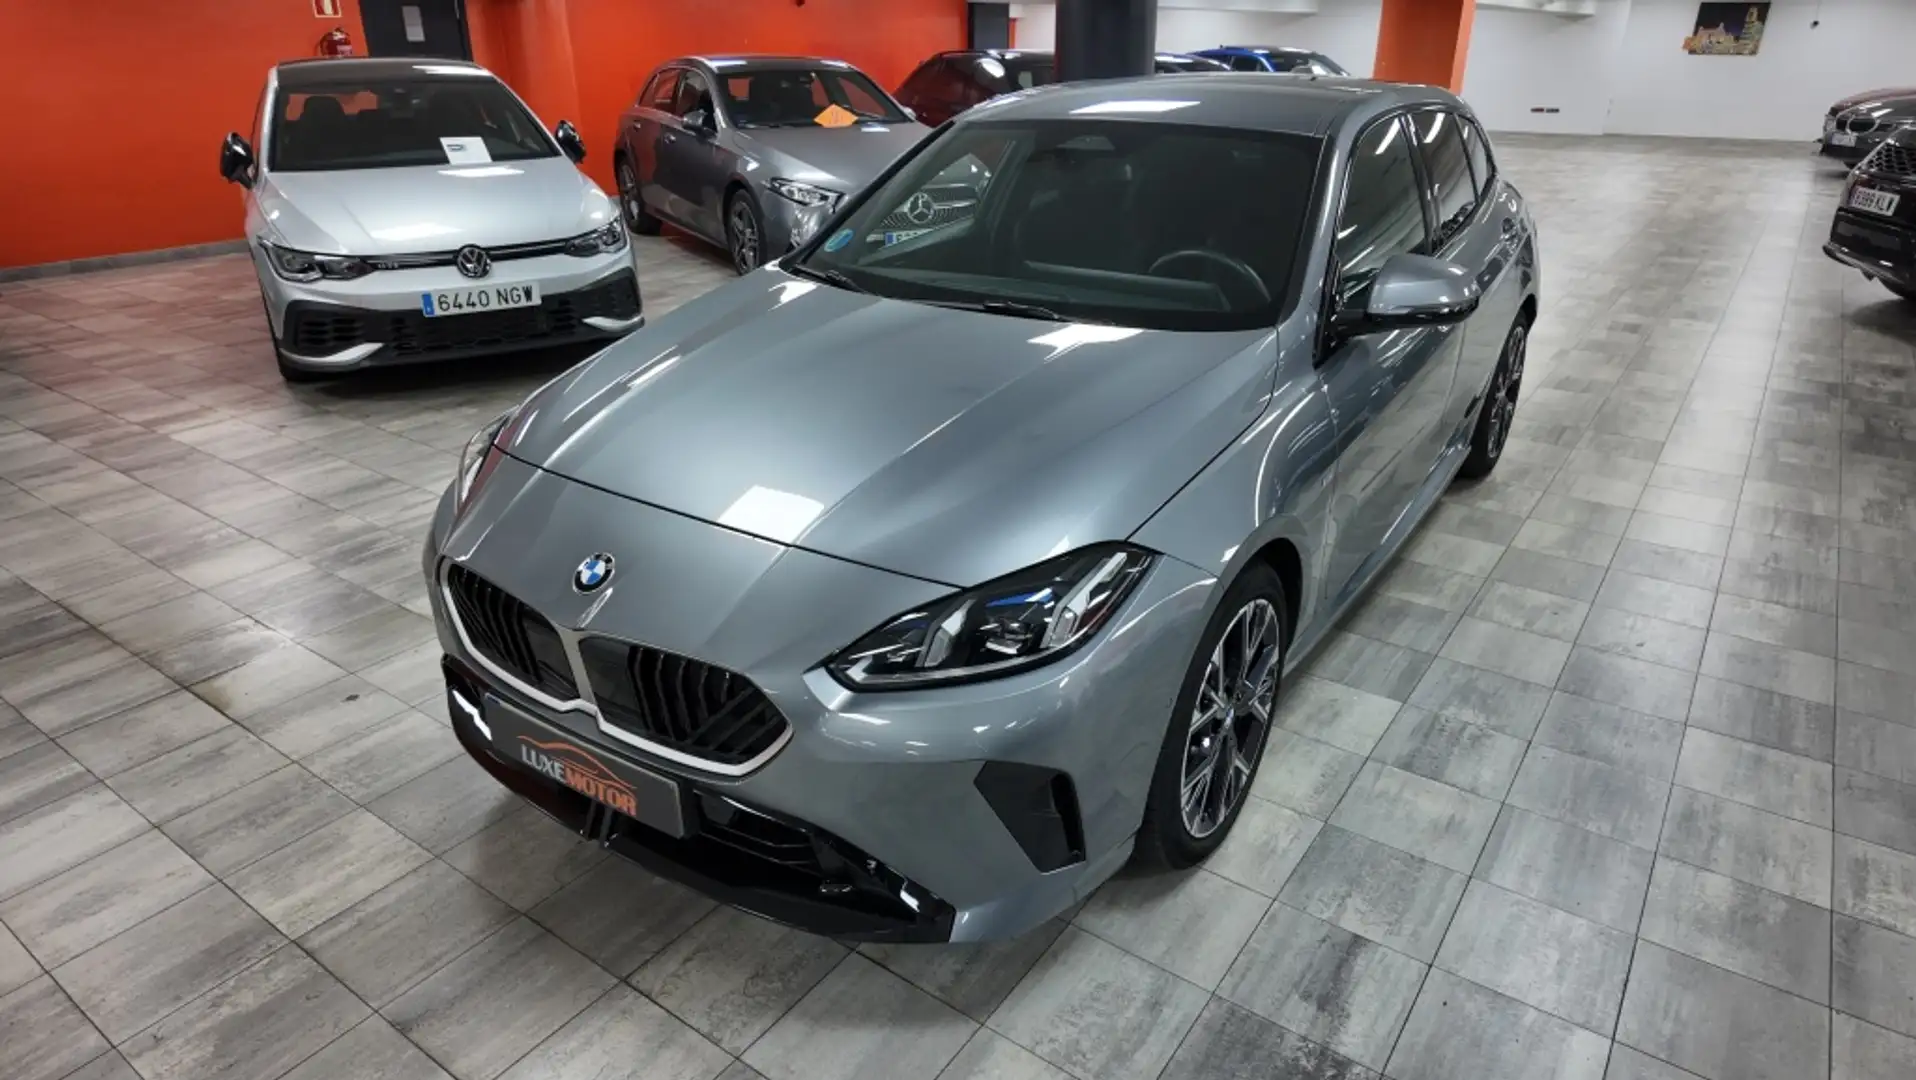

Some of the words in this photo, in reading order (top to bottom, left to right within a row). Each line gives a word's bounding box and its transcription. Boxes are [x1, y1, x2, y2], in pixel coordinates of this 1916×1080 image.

[438, 290, 490, 311] 6440
[496, 285, 533, 305] NGW
[521, 743, 637, 815] LUXEMOTOR
